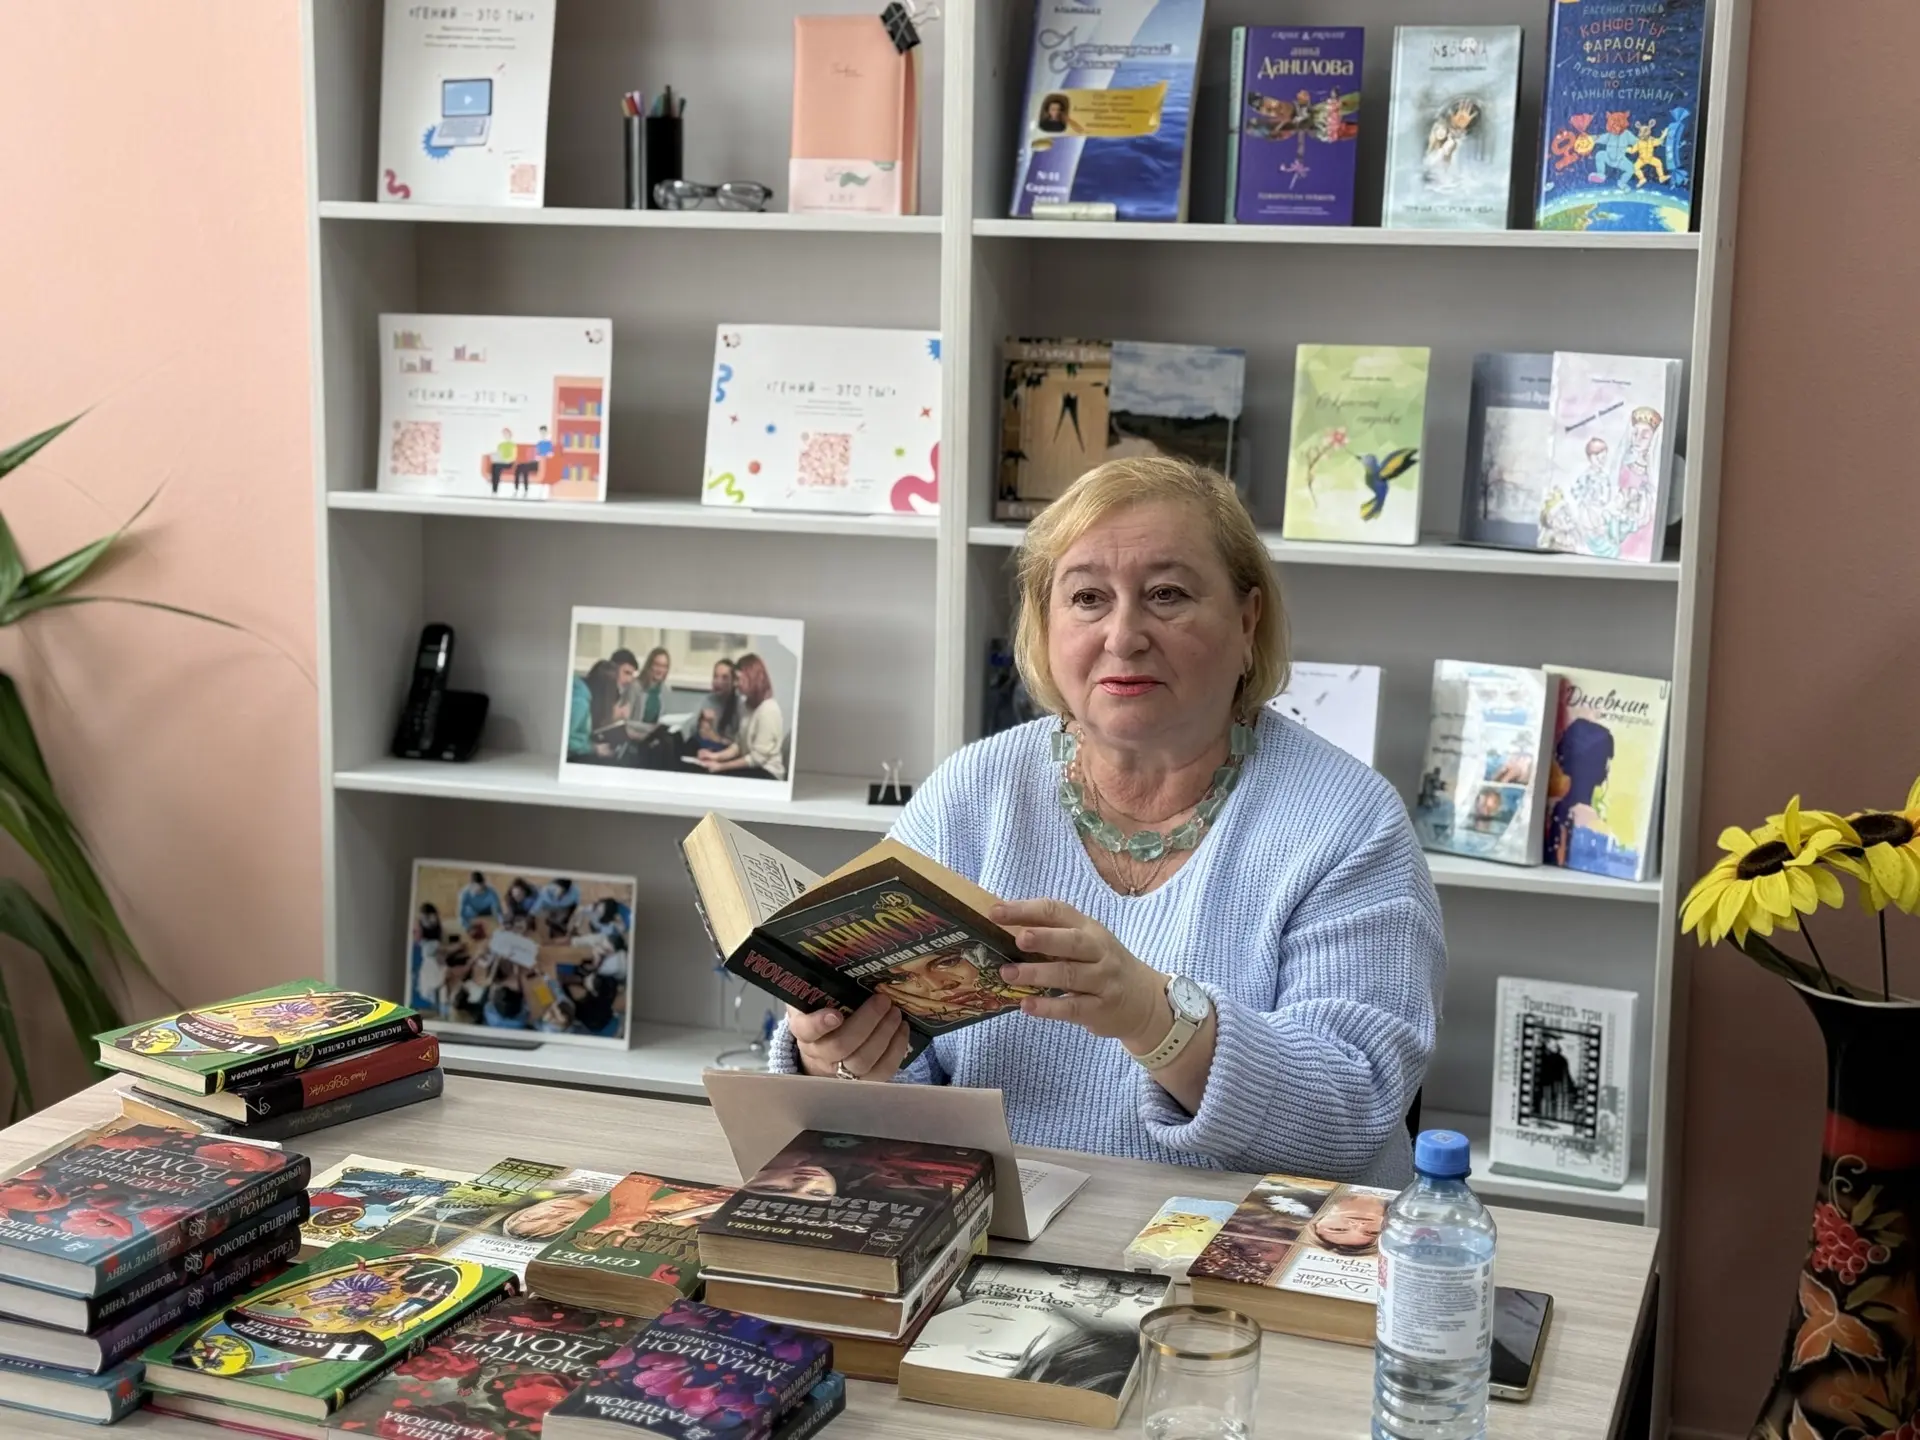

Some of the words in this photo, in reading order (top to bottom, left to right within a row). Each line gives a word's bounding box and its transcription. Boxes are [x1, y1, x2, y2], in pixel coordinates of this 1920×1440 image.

[1579, 17, 1666, 38] КОНФЕТЫ
[1583, 37, 1656, 54] ФАРАОНА
[1257, 55, 1354, 80] Данилова
[1617, 87, 1674, 103] СТРАНАМ
[1567, 685, 1650, 716] Дневник
[798, 904, 957, 970] ДАНИЛОВА
[803, 911, 863, 937] АННА
[843, 961, 885, 979] КОГДА
[882, 948, 917, 967] МЕНЯ
[914, 941, 932, 957] НЕ
[928, 930, 970, 950] СТАЛО
[743, 949, 827, 1005] ДАНИЛОВА
[75, 1155, 219, 1189] ДОРОЖНЫЙ
[97, 1147, 235, 1181] РОМАН
[58, 1163, 196, 1198] МАЛЕНЬКИЙ
[238, 1189, 279, 1219] РОМАН
[737, 1197, 881, 1225] ЗЕЛЕНЫЕ
[829, 1195, 926, 1218] ГЛАЗА
[0, 1216, 87, 1242] ДАНИЛО
[726, 1220, 794, 1236] ВОЛКОВА
[887, 1216, 916, 1230] И
[98, 1297, 126, 1319] АННА
[126, 1270, 178, 1307] ДАНИЛОВА
[212, 1226, 259, 1260] РОКОВОЕ
[257, 1206, 301, 1238] РЕШЕНИЕ
[106, 1261, 133, 1283] АННА
[132, 1235, 182, 1271] ДАНИЛОВА
[551, 1248, 641, 1268] СЕРОВА
[1305, 1254, 1372, 1269] страсти
[110, 1332, 136, 1356] АННА
[134, 1306, 182, 1347] ДАНИЛОВА
[211, 1260, 251, 1295] ПЕРВЫЙ
[250, 1238, 295, 1272] ВЫСТРЕЛ
[1296, 1272, 1375, 1294] Дубчак
[1040, 1297, 1076, 1309] Son
[231, 1321, 374, 1362] НАСЛЕДСТВО
[245, 1319, 302, 1338] СКЛЕПА
[303, 1331, 328, 1340] ИЗ
[491, 1329, 606, 1361] ДОМ
[646, 1330, 757, 1359] КОЛОМБИНЫ
[451, 1340, 600, 1379] ЗАБЫТЫЙ
[636, 1337, 783, 1382] МИЛЛИОН
[758, 1354, 796, 1373] ДЛЯ
[584, 1393, 701, 1426] ДАНИЛОВА
[599, 1405, 663, 1426] АННА
[384, 1410, 495, 1438] ДАНИЛОВА
